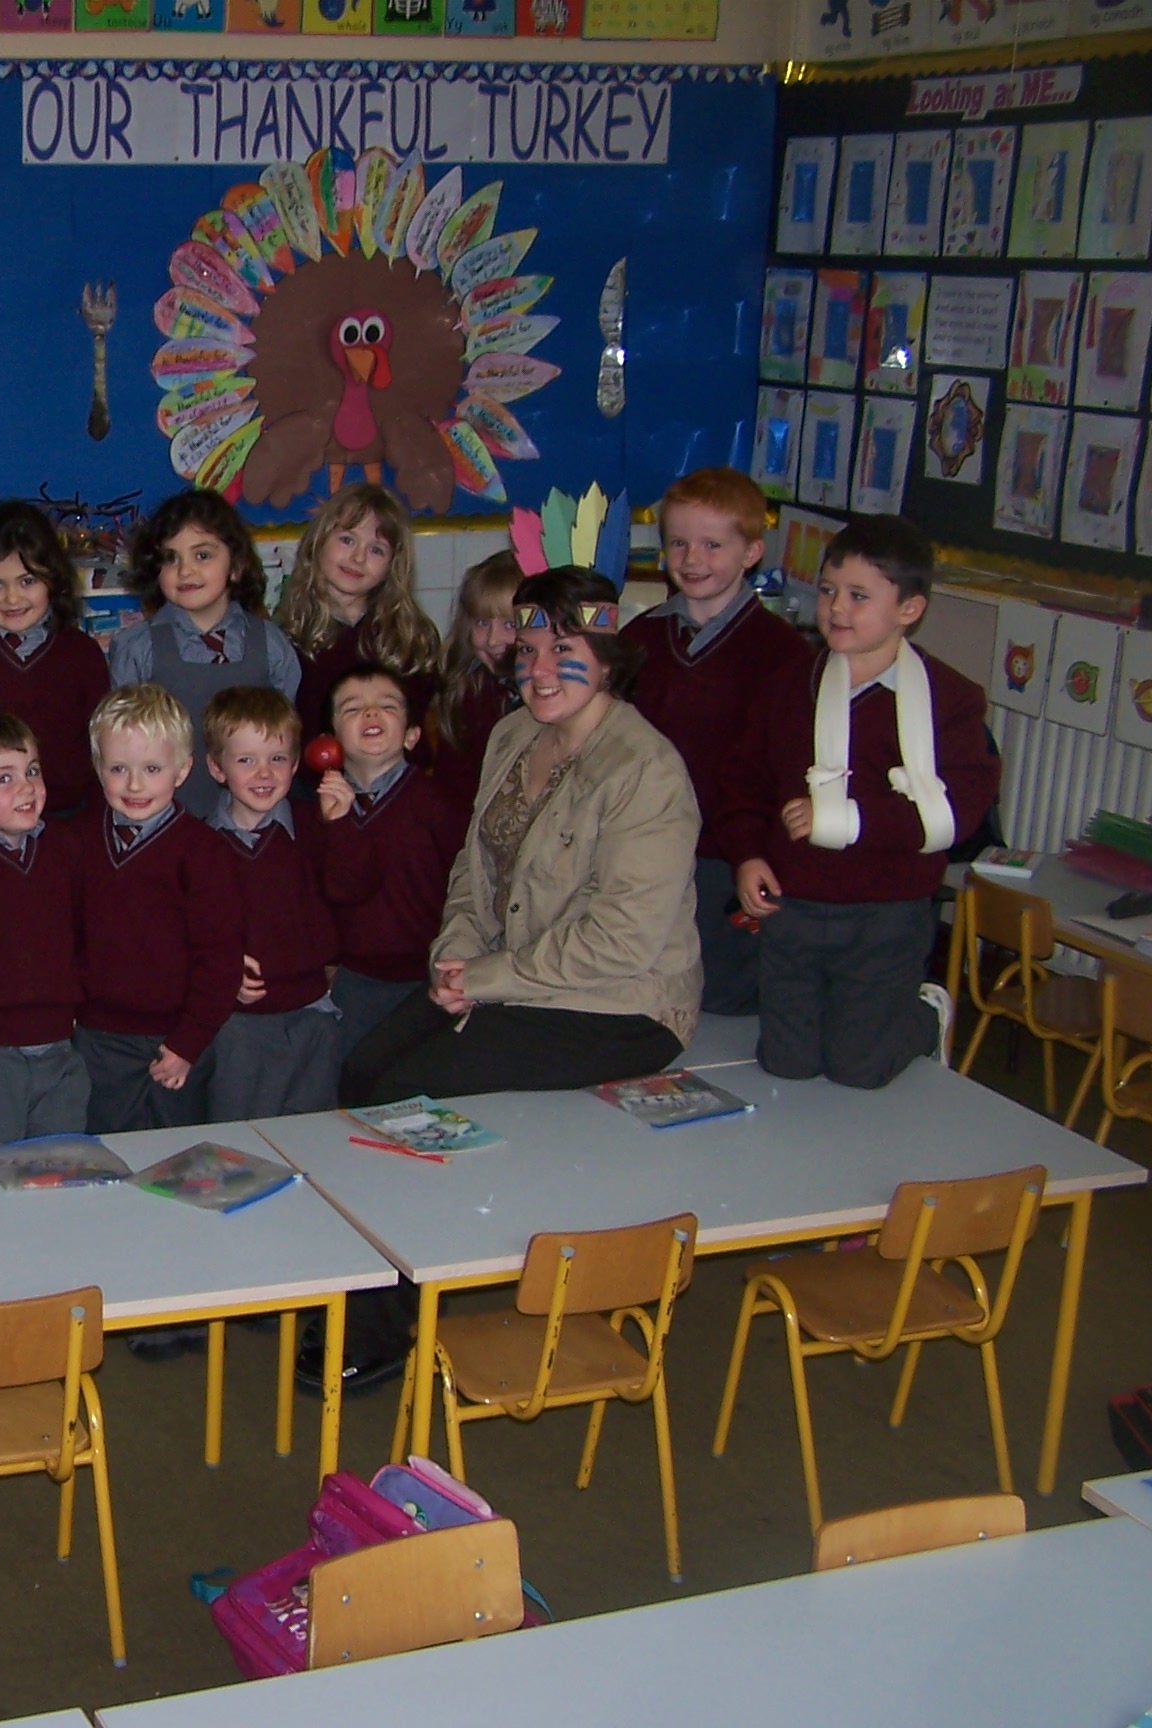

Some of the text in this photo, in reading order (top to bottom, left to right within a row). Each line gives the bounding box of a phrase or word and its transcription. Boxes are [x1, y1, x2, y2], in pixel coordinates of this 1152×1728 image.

[26, 78, 668, 161] OUR THANKFUL TURKEY
[905, 79, 986, 117] Looking
